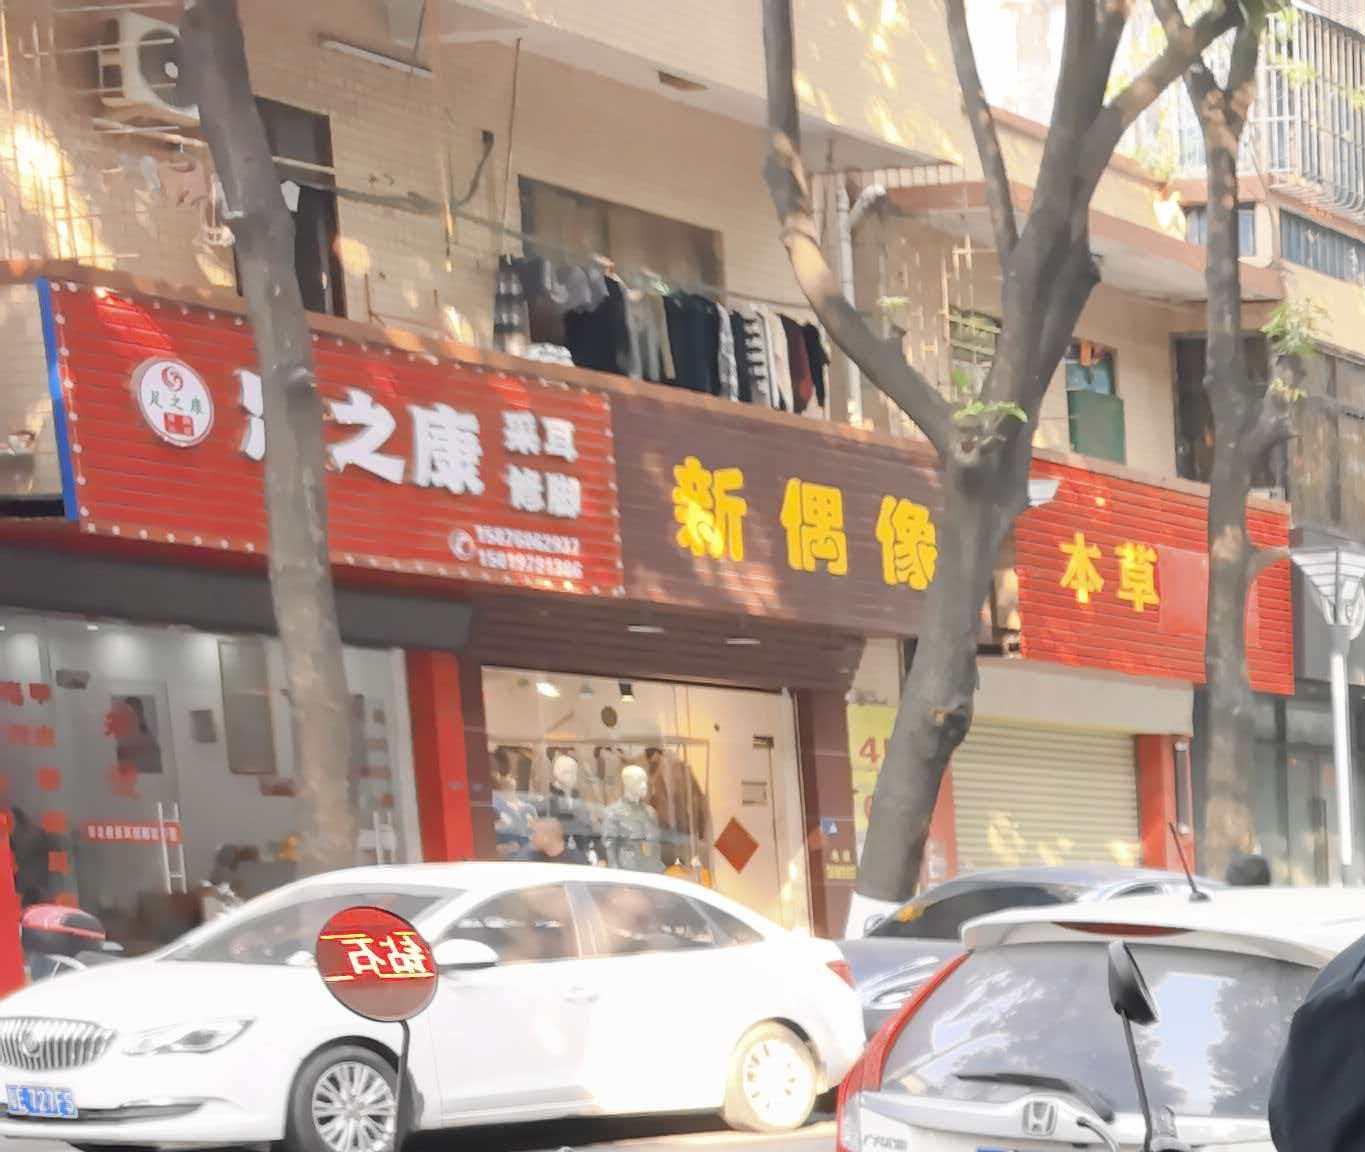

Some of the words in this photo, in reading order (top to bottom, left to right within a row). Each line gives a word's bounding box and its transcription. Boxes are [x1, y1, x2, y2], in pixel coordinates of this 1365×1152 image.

[672, 455, 938, 592] 新偶像
[1060, 532, 1161, 613] 本草
